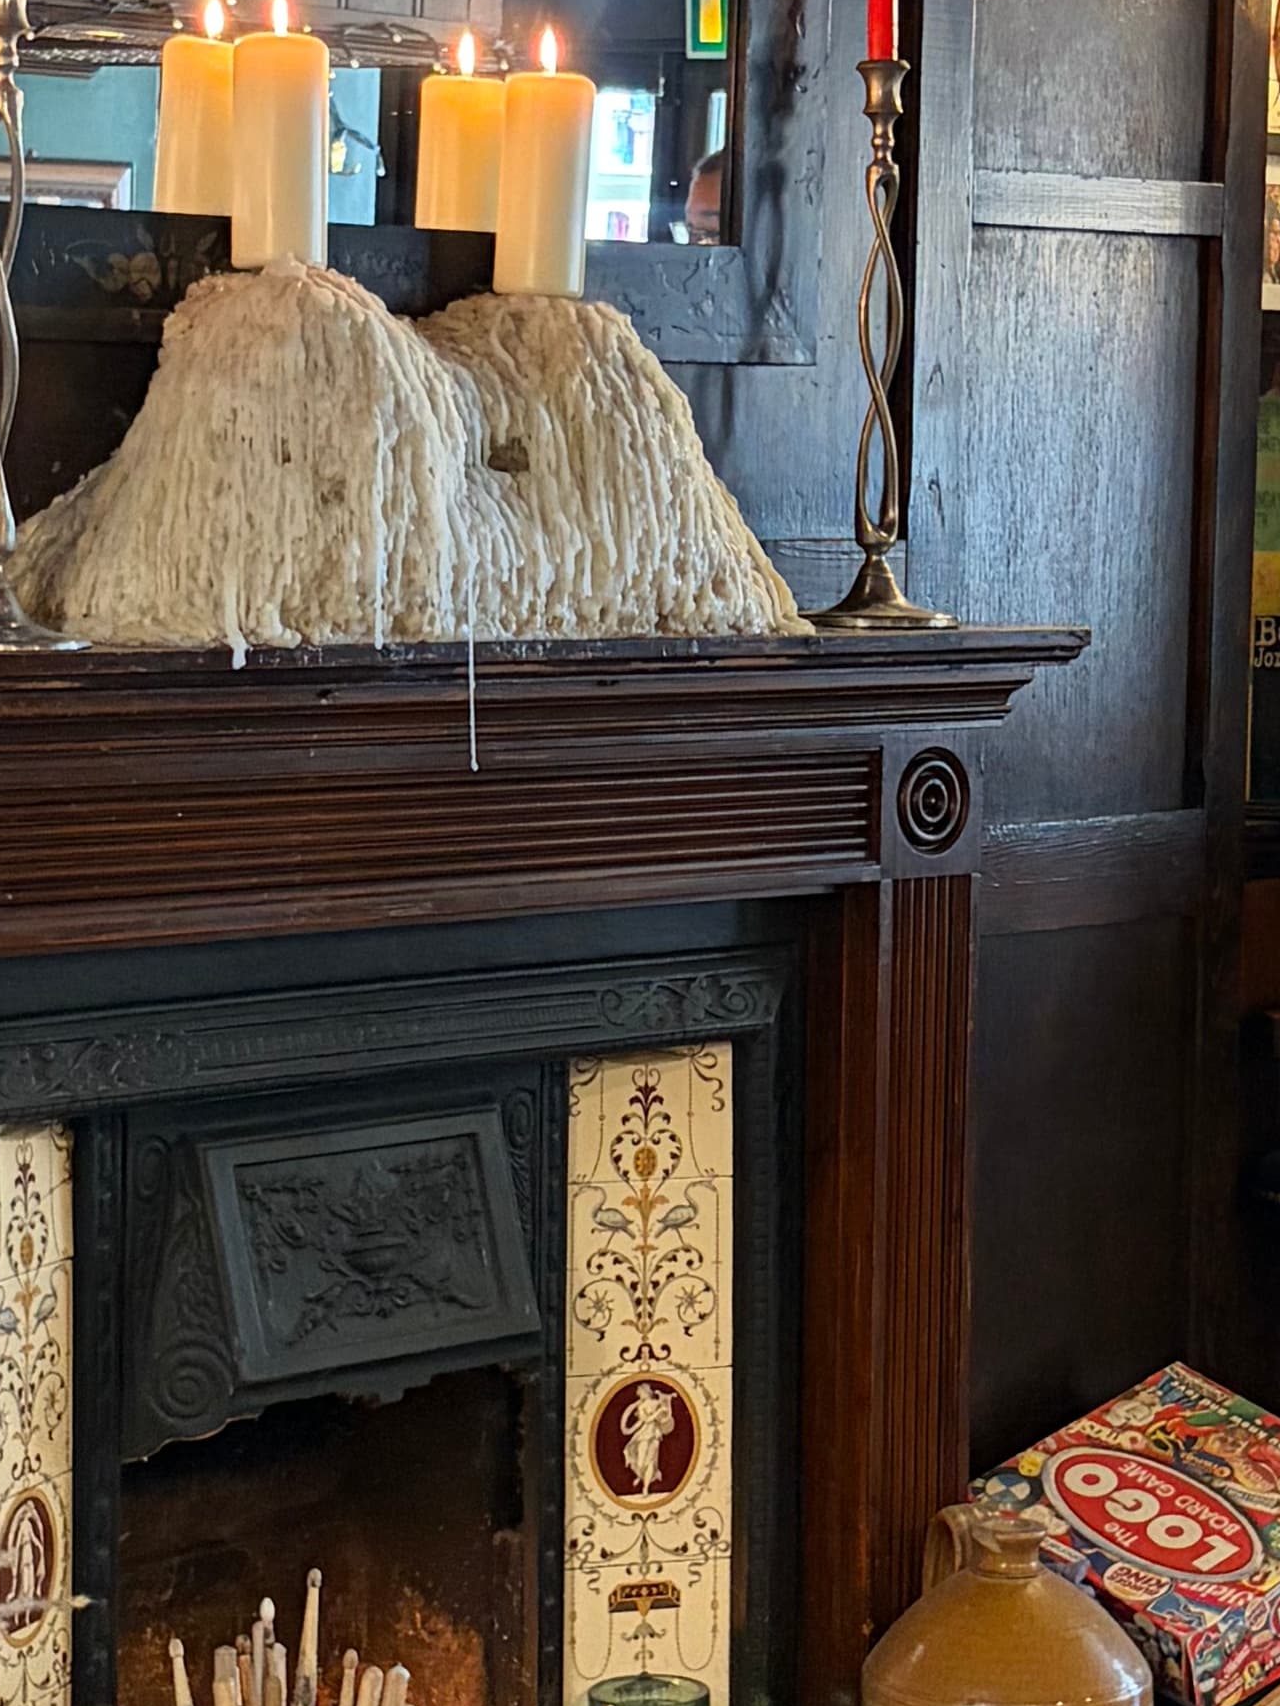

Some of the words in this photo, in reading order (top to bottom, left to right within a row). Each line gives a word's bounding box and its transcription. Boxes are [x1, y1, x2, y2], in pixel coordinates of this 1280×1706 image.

[1228, 1415, 1266, 1445] know
[1118, 1460, 1176, 1497] GAME
[1063, 1462, 1240, 1572] LOGO
[1174, 1494, 1241, 1535] BOARD
[1102, 1520, 1138, 1548] The
